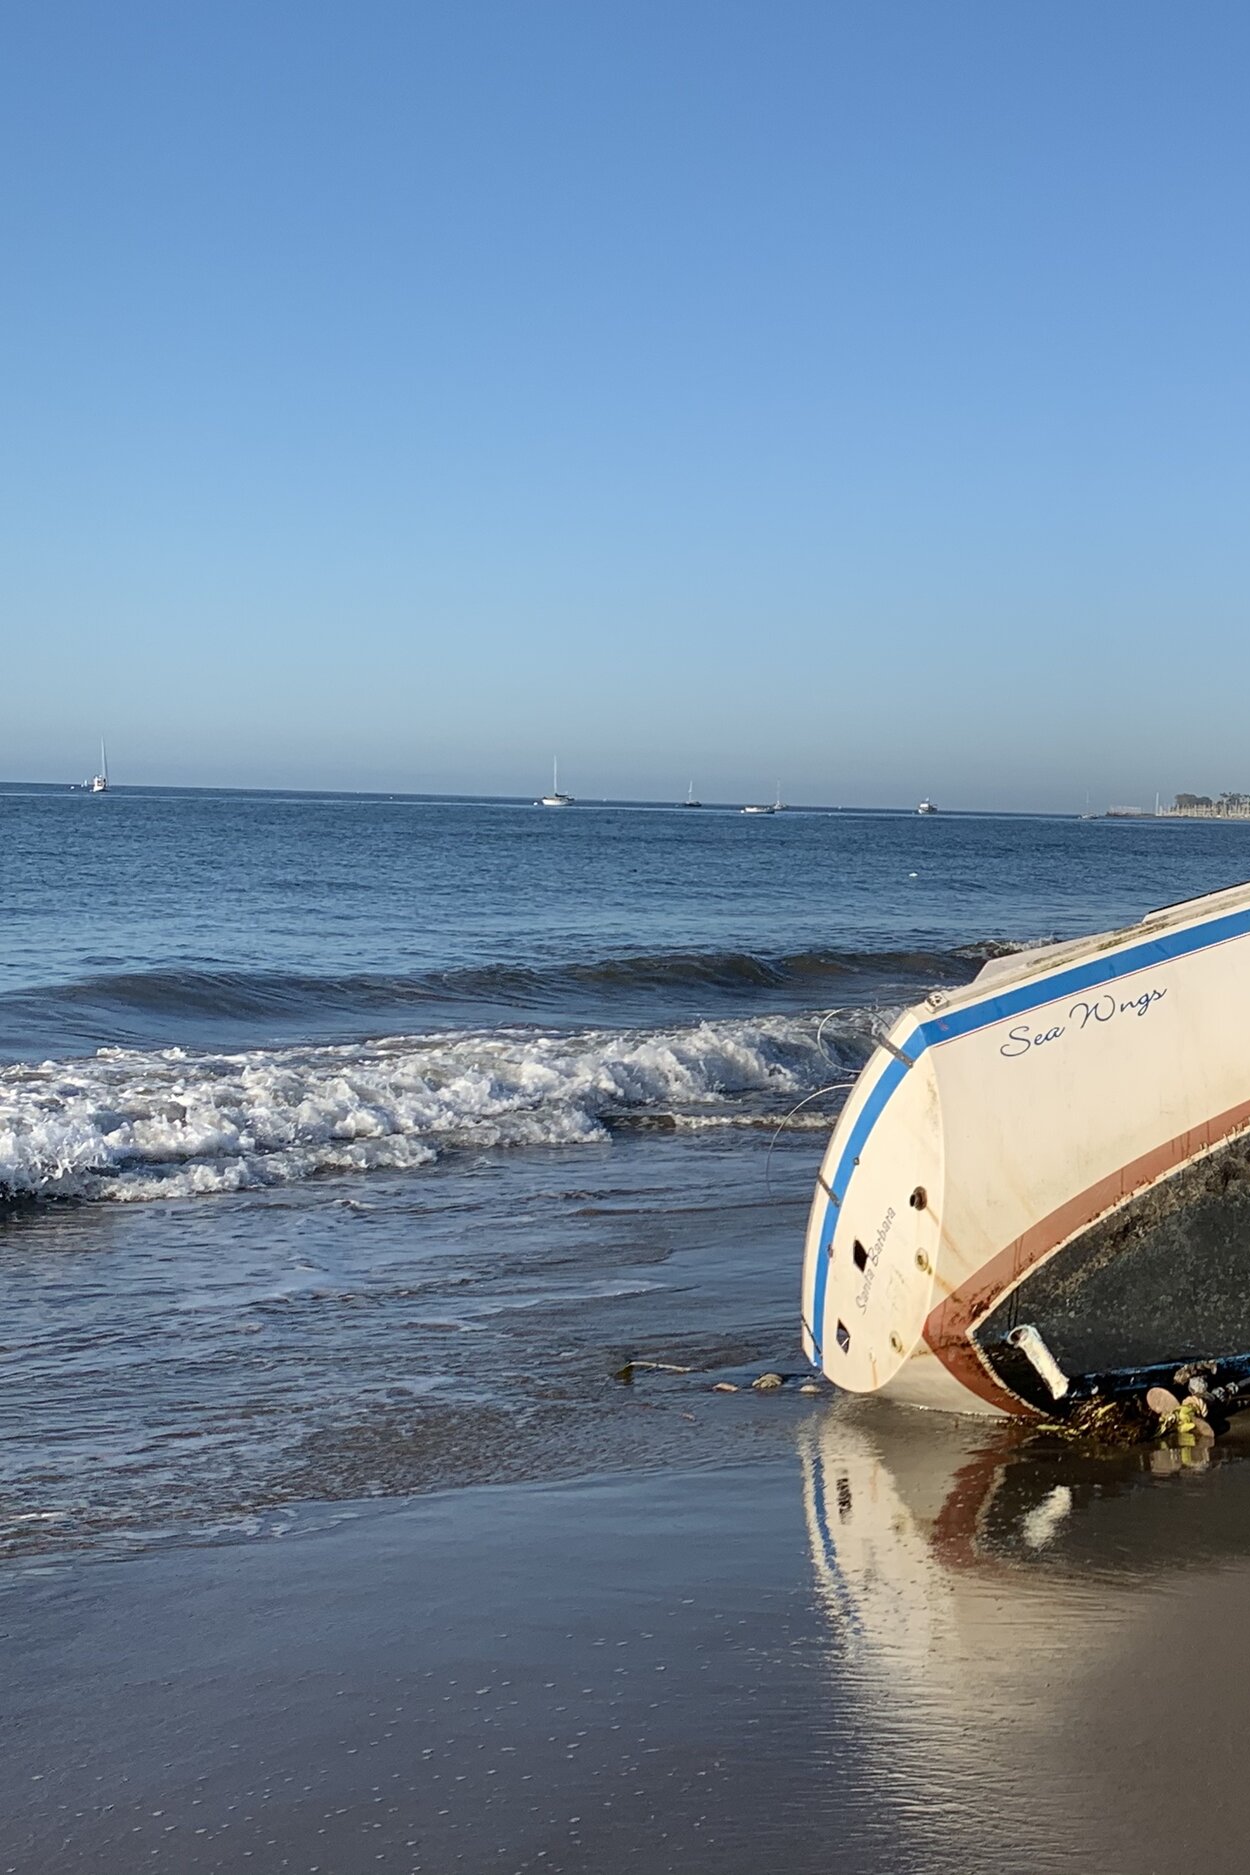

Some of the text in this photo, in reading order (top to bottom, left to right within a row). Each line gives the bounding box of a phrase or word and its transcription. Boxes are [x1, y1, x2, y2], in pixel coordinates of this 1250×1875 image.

[1000, 1025, 1065, 1057] Sea
[855, 1207, 897, 1316] Santa Barbara
